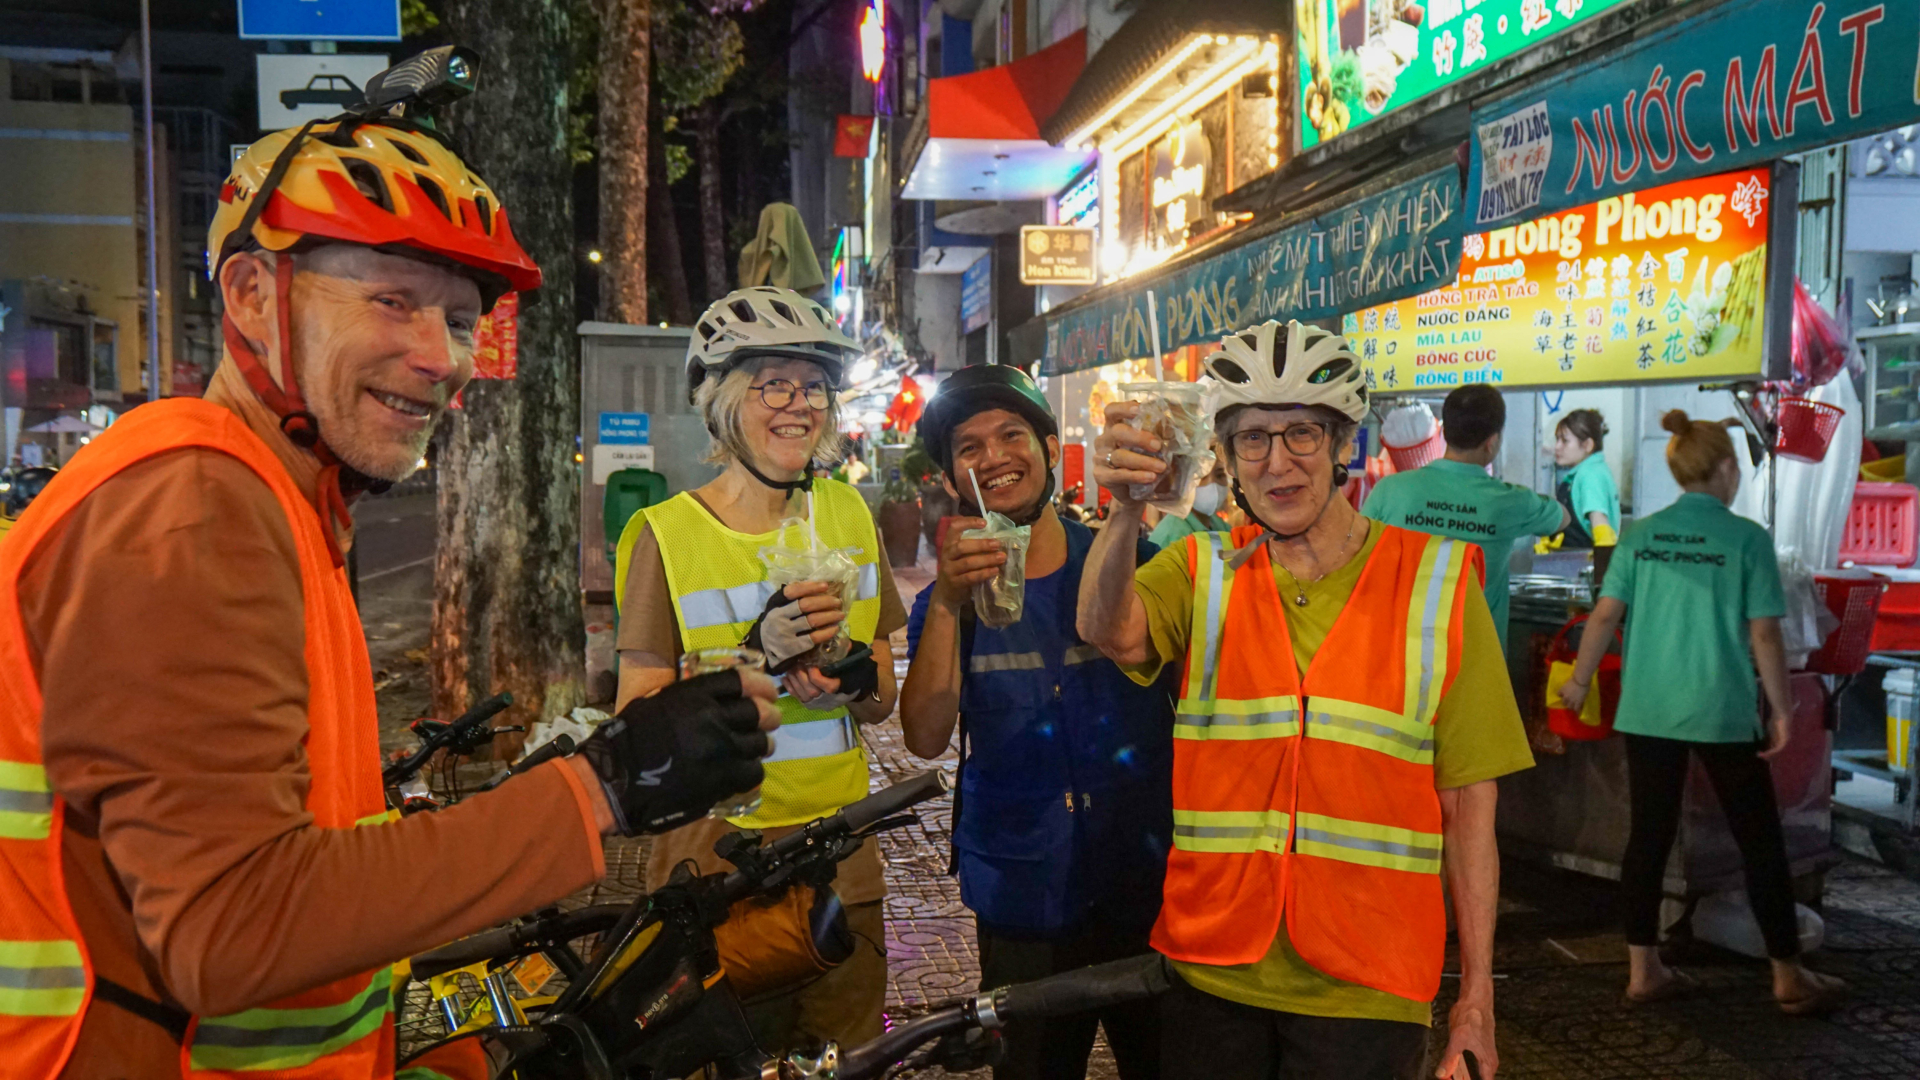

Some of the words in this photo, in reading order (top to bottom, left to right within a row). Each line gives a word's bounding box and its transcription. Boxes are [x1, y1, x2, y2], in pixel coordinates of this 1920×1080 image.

[1566, 64, 1714, 194] NƯỚC
[1723, 2, 1884, 153] MÁT
[1595, 192, 1726, 246] Phong
[1386, 236, 1451, 290] KHÁT
[1464, 283, 1499, 302] TRÀ
[1417, 309, 1460, 328] NƯỚC
[1464, 303, 1511, 323] ĐẮNG
[1661, 247, 1689, 365] 百合花
[1383, 303, 1401, 389] 統口味
[1416, 330, 1446, 348] MÍA
[1451, 329, 1483, 345] LAU
[1416, 350, 1459, 367] BÔNG
[1463, 346, 1498, 363] CÚC
[1447, 518, 1496, 535] PHONG
[1673, 550, 1725, 567] PHONG
